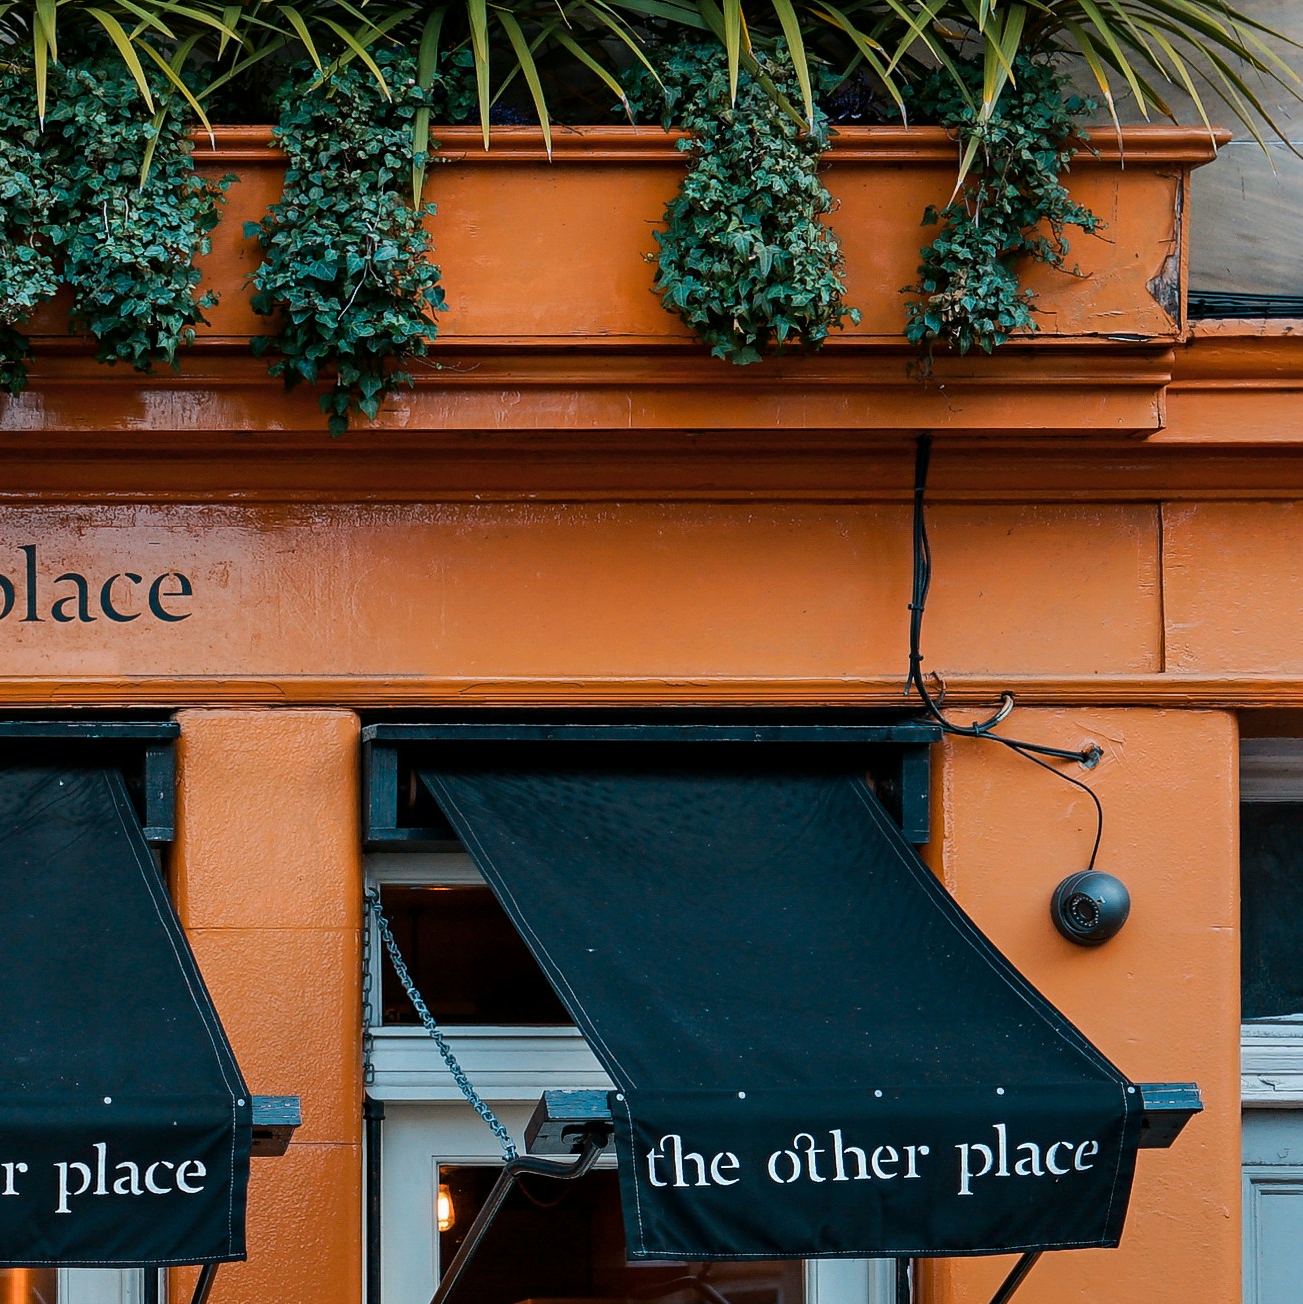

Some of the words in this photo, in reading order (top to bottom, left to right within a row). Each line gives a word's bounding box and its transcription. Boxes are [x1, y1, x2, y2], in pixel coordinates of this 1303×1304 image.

[54, 1142, 207, 1213] place
[646, 1134, 740, 1187] the
[768, 1129, 929, 1183] other
[954, 1123, 1099, 1195] place
